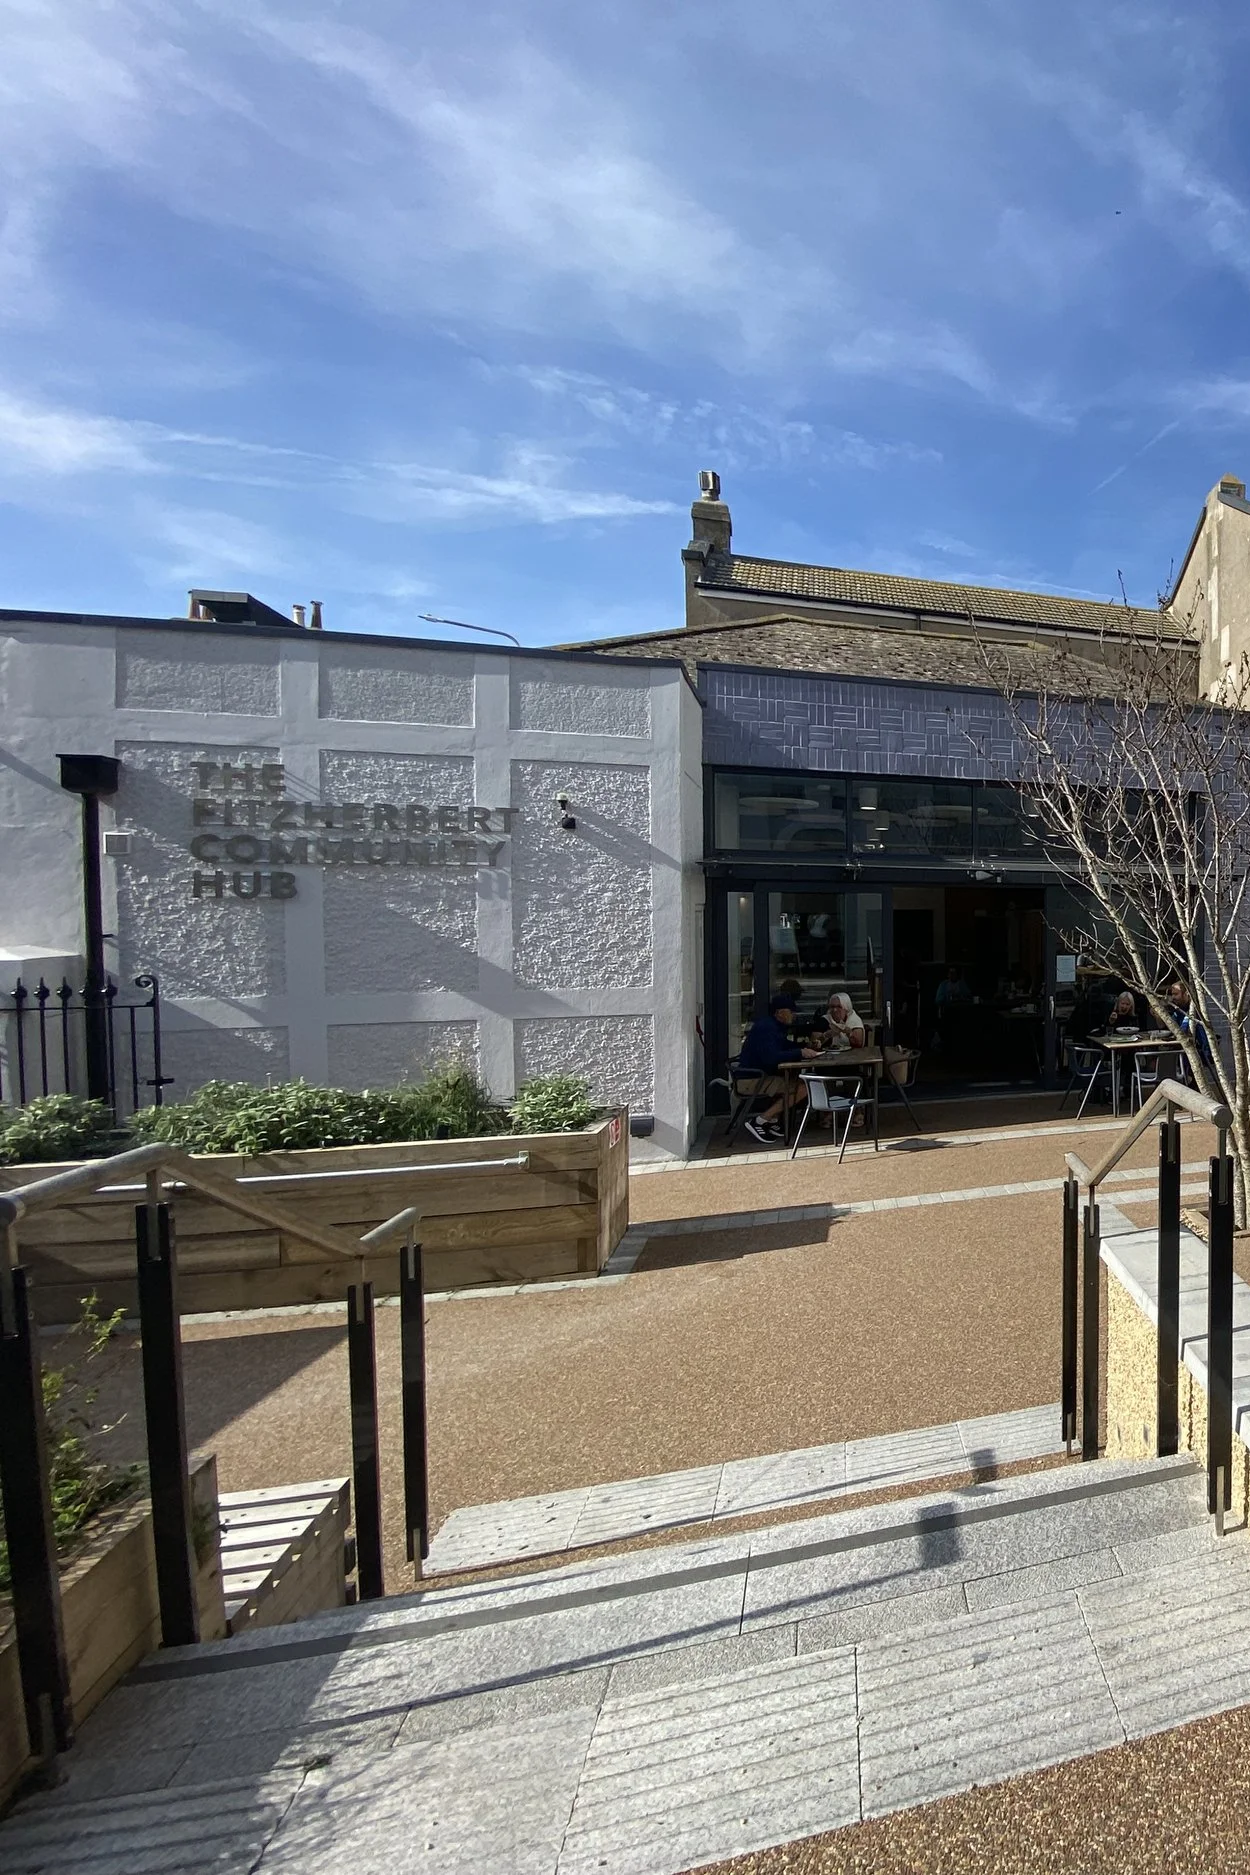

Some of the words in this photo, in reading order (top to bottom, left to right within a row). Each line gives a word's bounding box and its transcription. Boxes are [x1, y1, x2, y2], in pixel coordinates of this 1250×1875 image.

[190, 762, 286, 791] THE
[193, 799, 520, 833] FITZHERBERT
[190, 834, 506, 867] COMMUNITY
[193, 870, 298, 899] HUB
